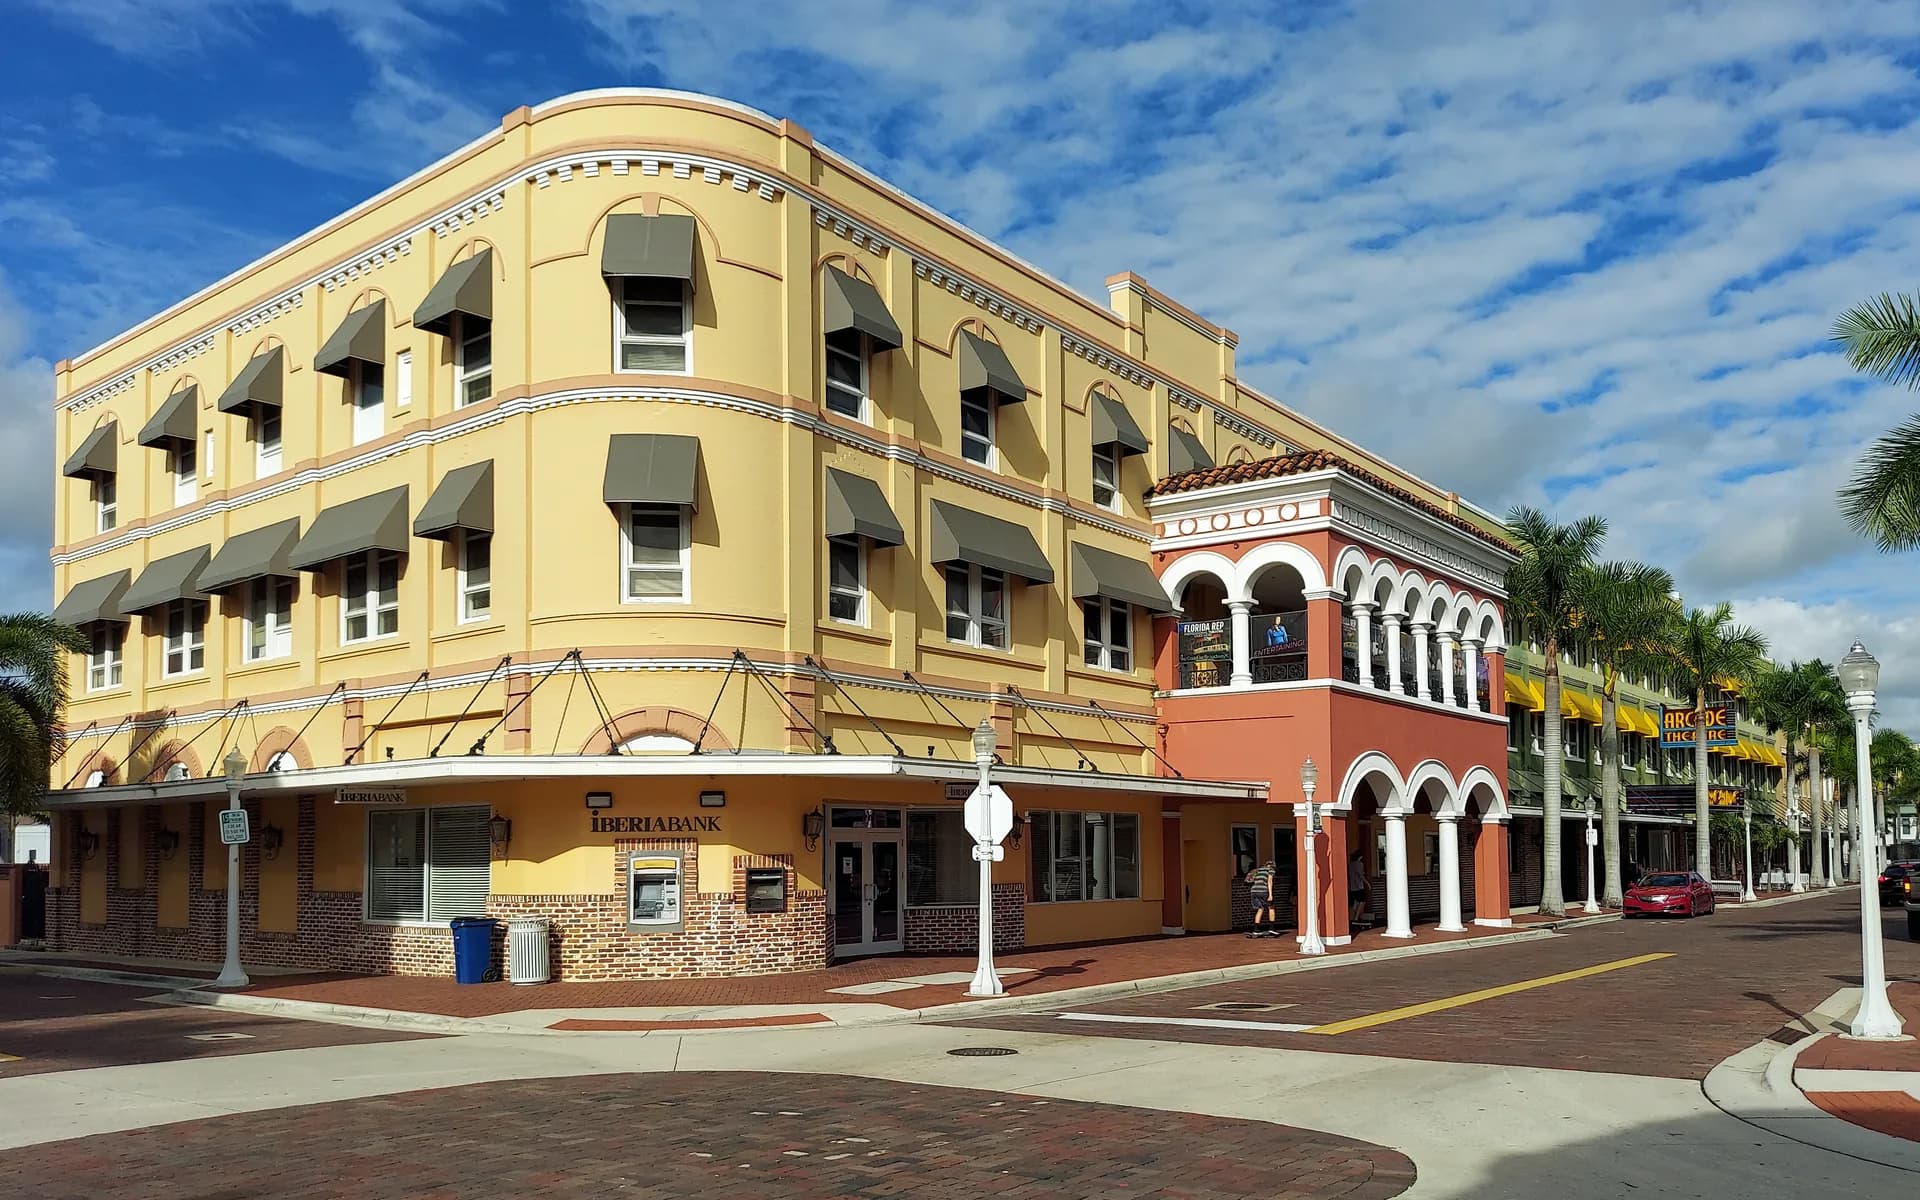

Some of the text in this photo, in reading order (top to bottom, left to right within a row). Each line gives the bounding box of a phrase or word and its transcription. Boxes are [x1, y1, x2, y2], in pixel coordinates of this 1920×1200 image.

[1183, 621, 1225, 633] FLORIDA REP
[1664, 709, 1726, 729] ARCDE
[1664, 729, 1726, 742] THERE
[590, 809, 722, 832] iBERIABANK
